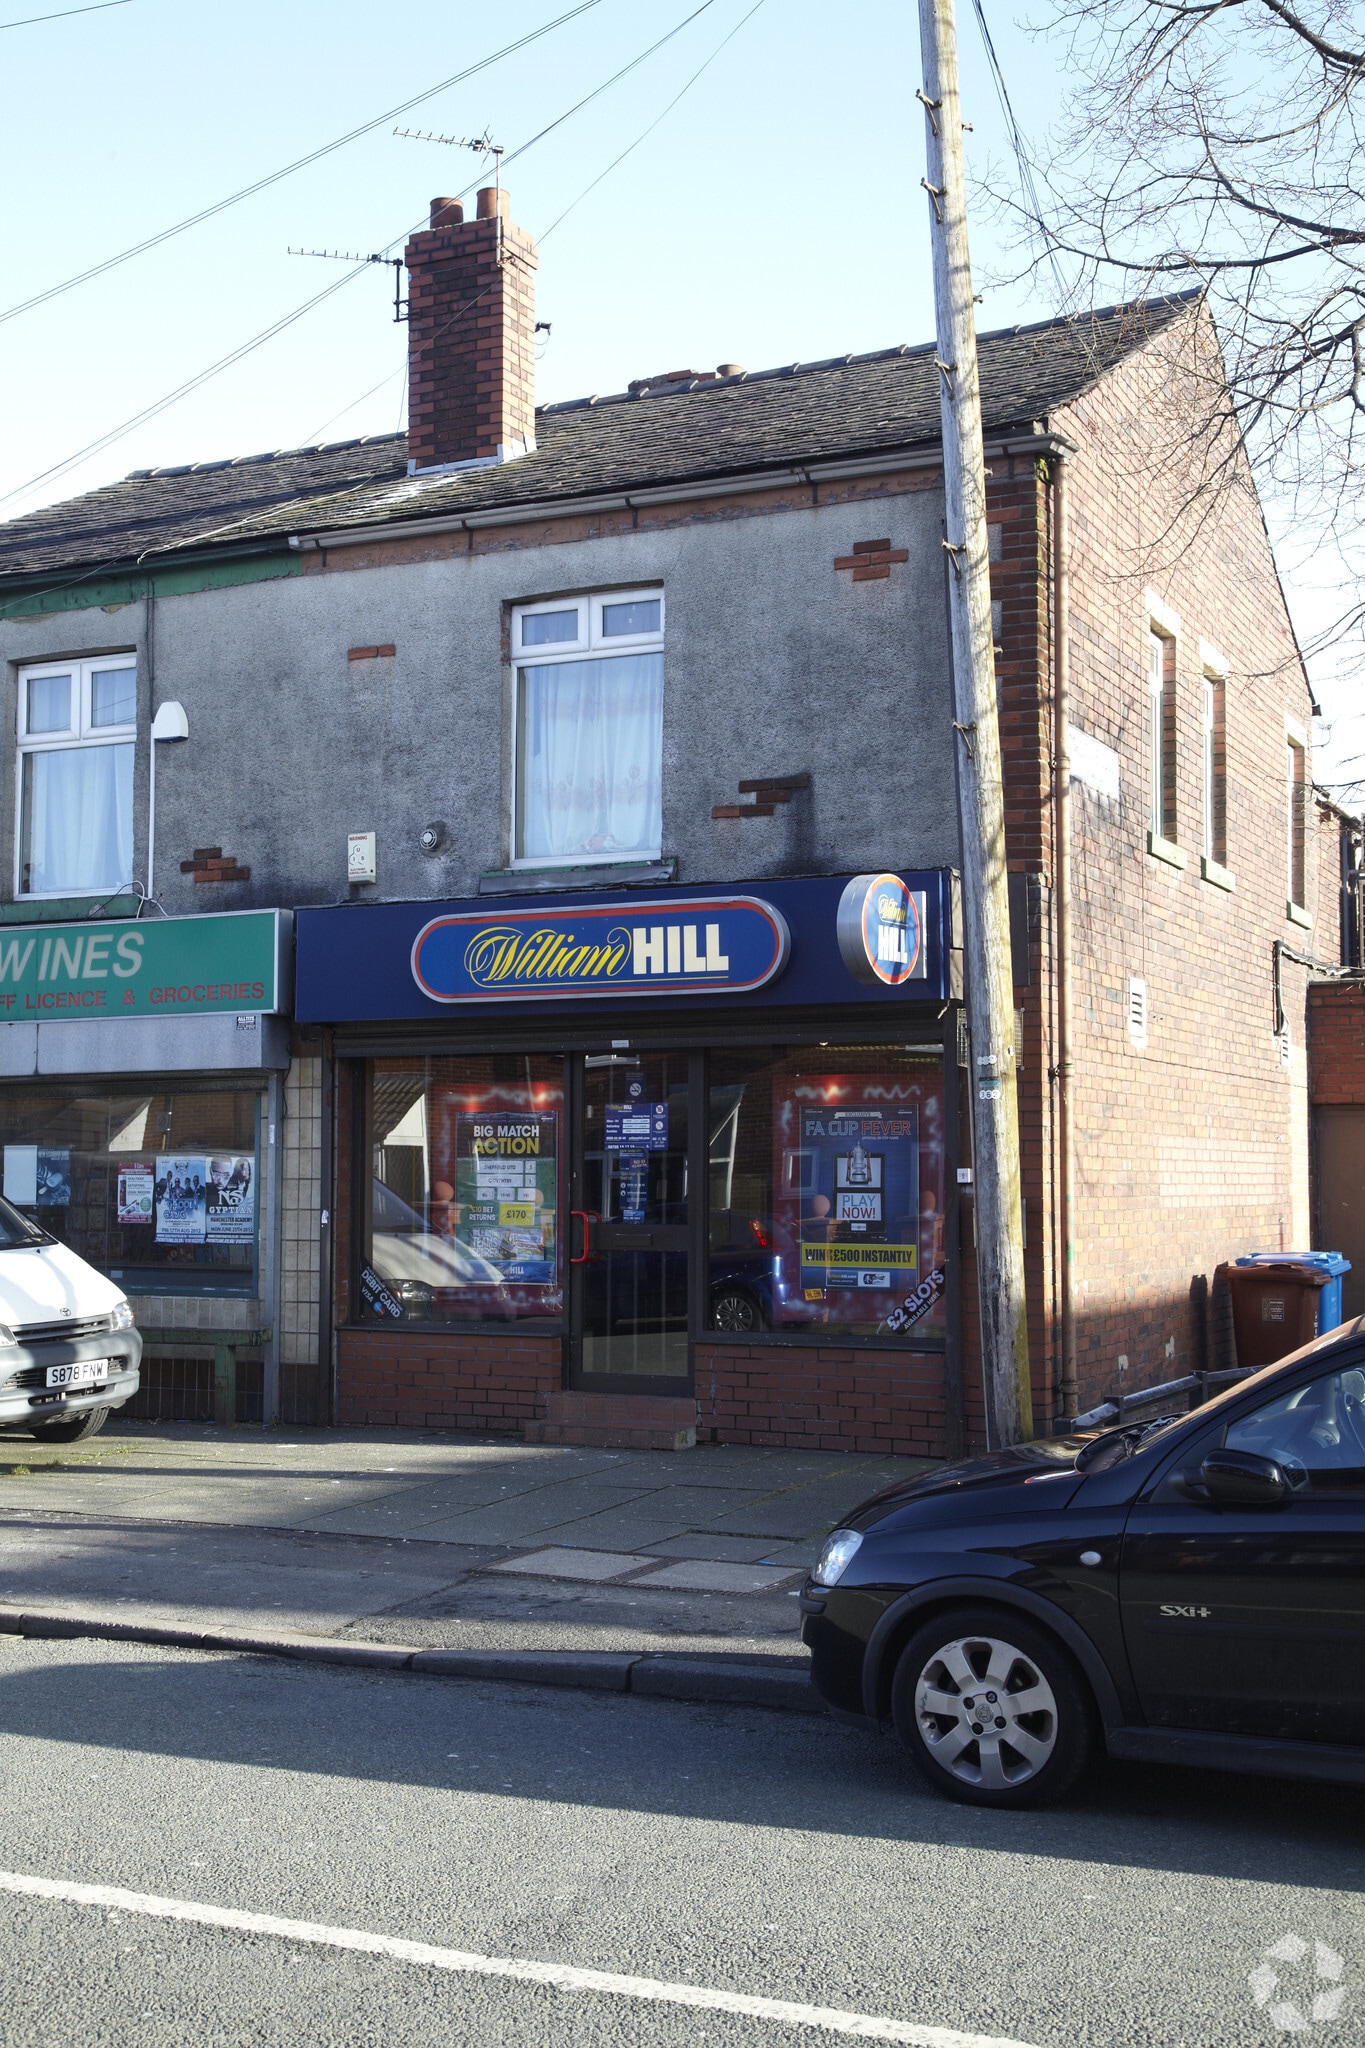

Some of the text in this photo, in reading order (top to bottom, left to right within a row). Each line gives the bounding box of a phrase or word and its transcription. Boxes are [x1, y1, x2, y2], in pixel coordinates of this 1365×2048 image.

[878, 924, 908, 964] HILL
[464, 924, 729, 982] William HILL
[25, 990, 107, 1009] LICENCE
[122, 989, 136, 1005] &
[149, 982, 265, 1004] GROCERIES
[473, 1125, 539, 1137] BIG MATCH
[805, 1120, 912, 1136] FA CUP FEVER
[472, 1137, 540, 1154] ACTION
[842, 1195, 876, 1207] PLAY
[208, 1206, 253, 1214] GYPTIAN
[506, 1210, 526, 1219] £170
[842, 1207, 876, 1219] NOW!
[834, 1249, 860, 1262] £500
[861, 1249, 912, 1263] INSTANTLY
[509, 1266, 524, 1274] HILL
[361, 1269, 383, 1294] DEBIT
[379, 1292, 401, 1318] CARD
[361, 1285, 374, 1303] VISA
[886, 1269, 945, 1331] £2 SLOTS
[903, 1290, 941, 1330] AVAILABLE HERE
[52, 1363, 104, 1383] S878 FNW
